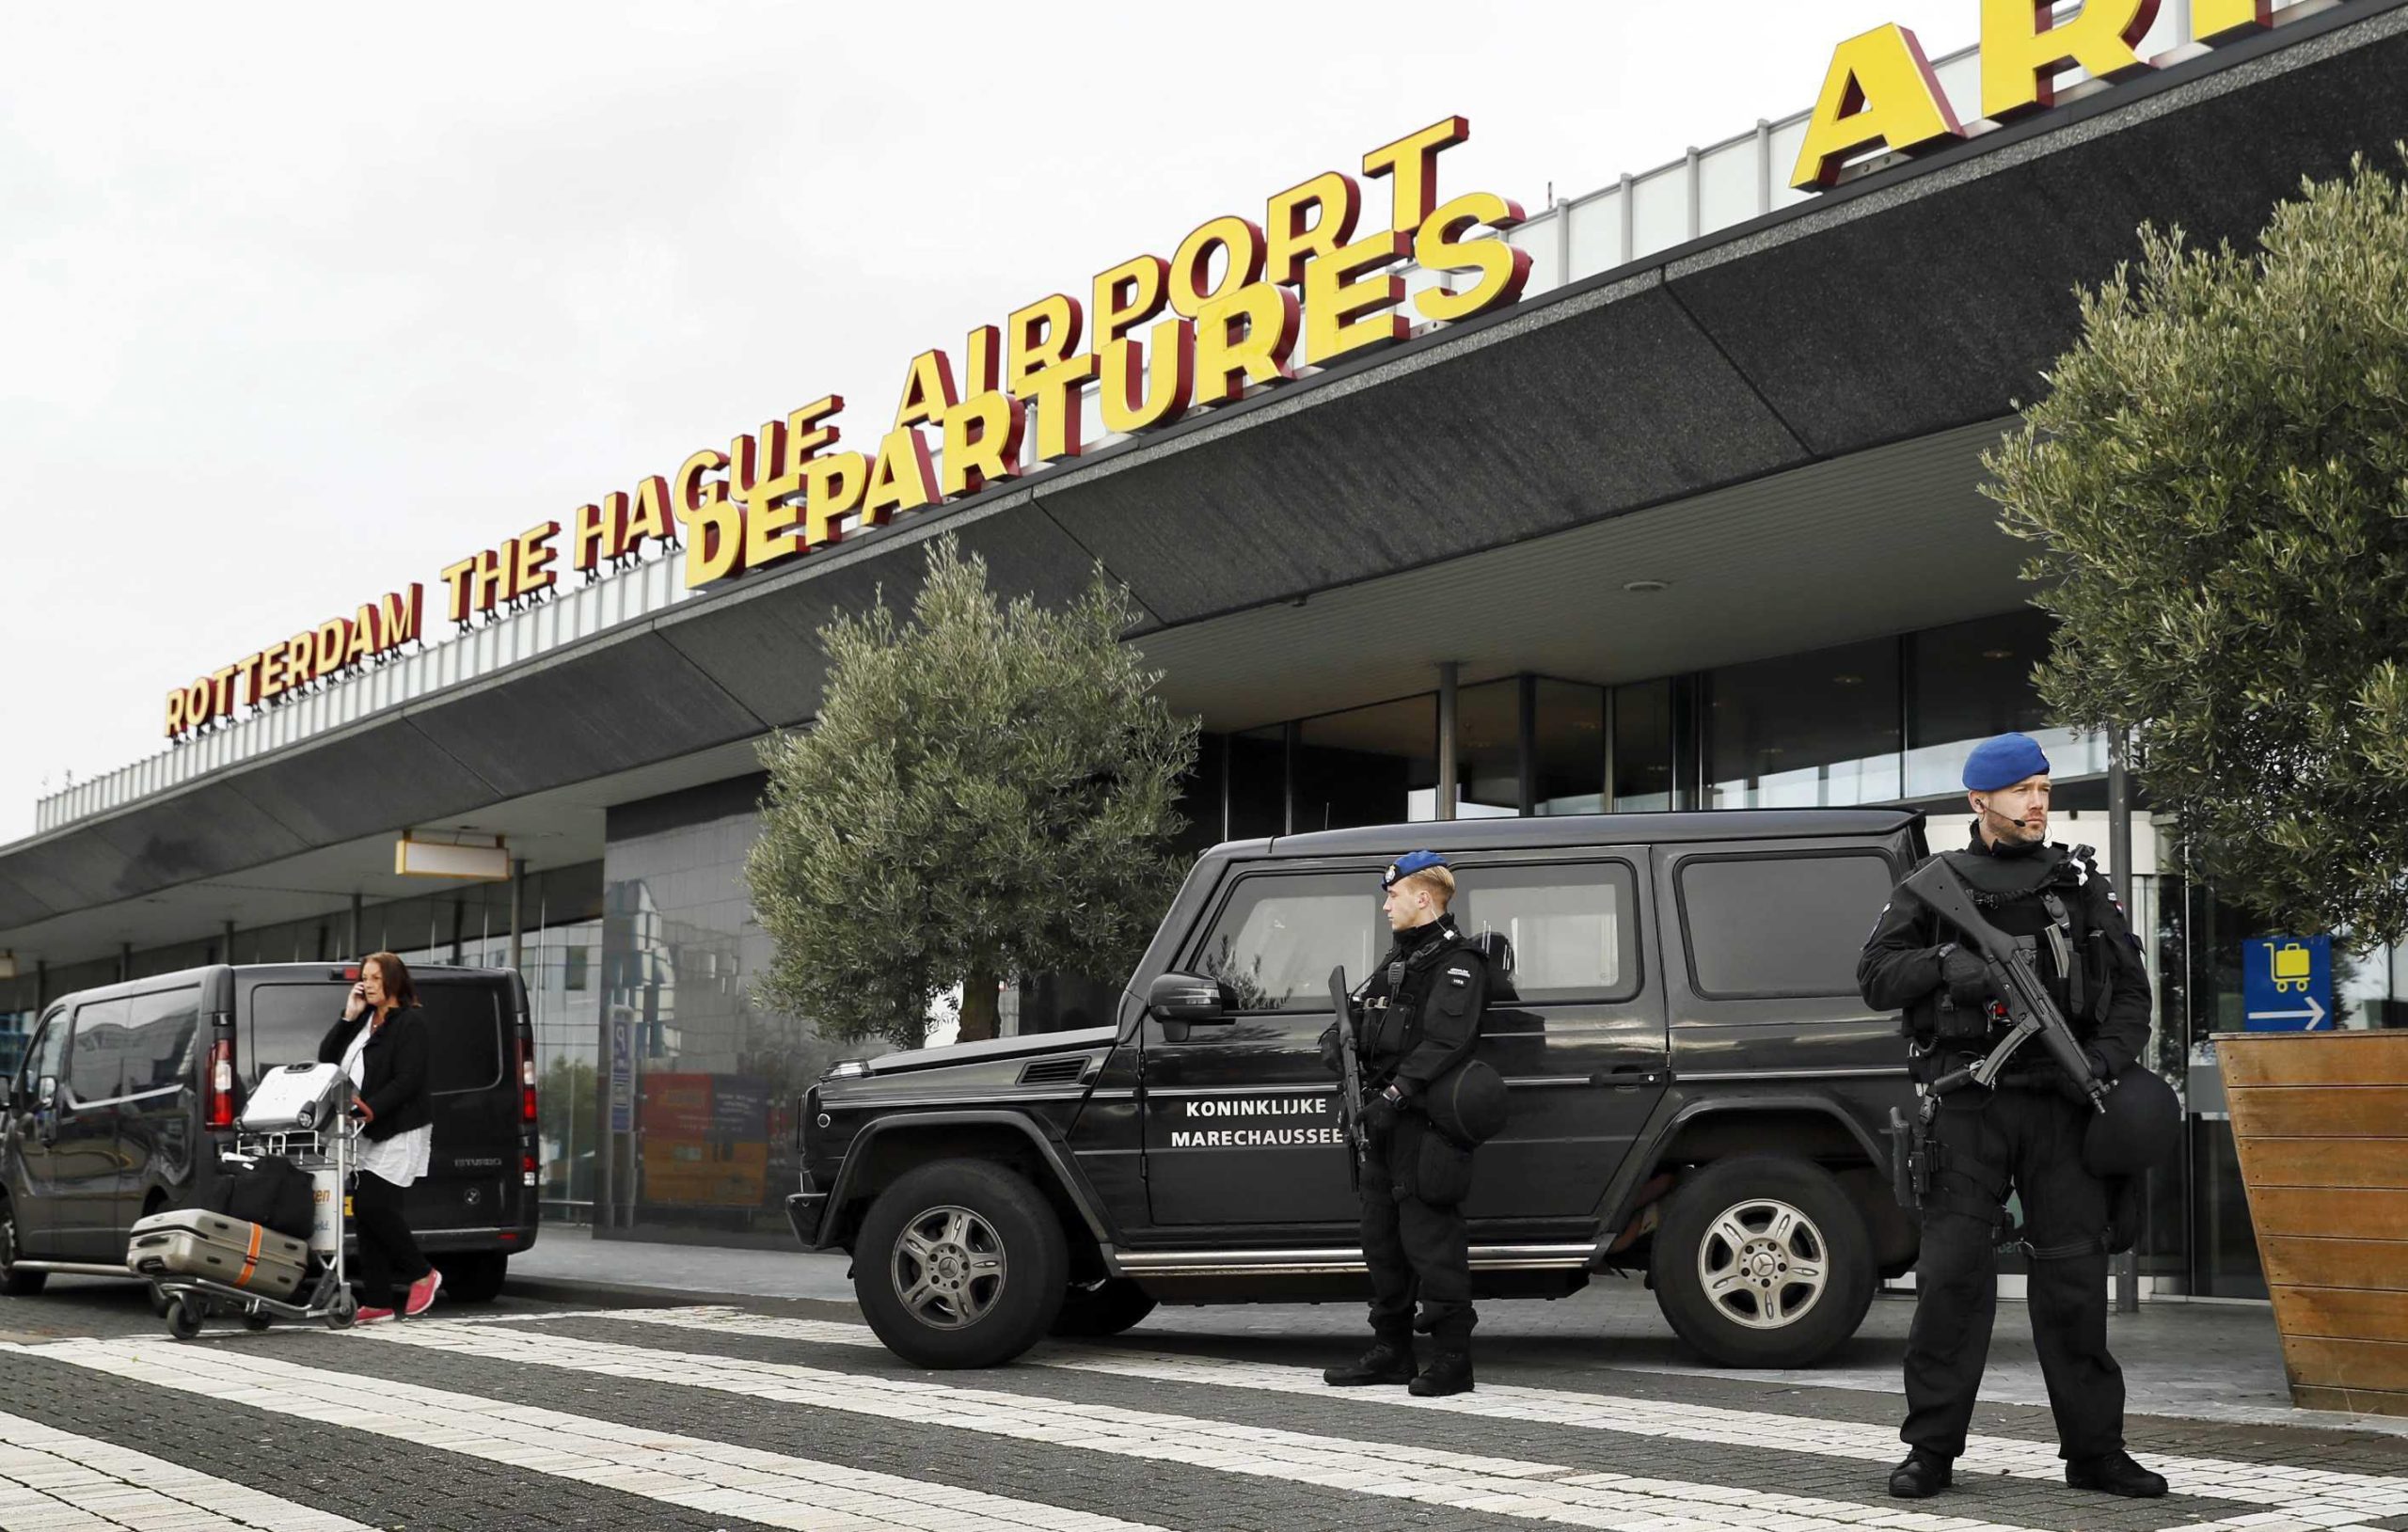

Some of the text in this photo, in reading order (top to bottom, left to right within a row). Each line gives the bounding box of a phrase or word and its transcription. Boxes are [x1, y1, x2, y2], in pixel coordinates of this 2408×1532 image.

[1789, 0, 2274, 191] AR
[165, 114, 1470, 738] ROTTERDAM THE HAGUE AIRPORT
[685, 191, 1534, 591] DEPARTURES
[1170, 1128, 1345, 1147] MARECHAUSSEE
[1185, 1098, 1327, 1118] KONINKLIJKE
